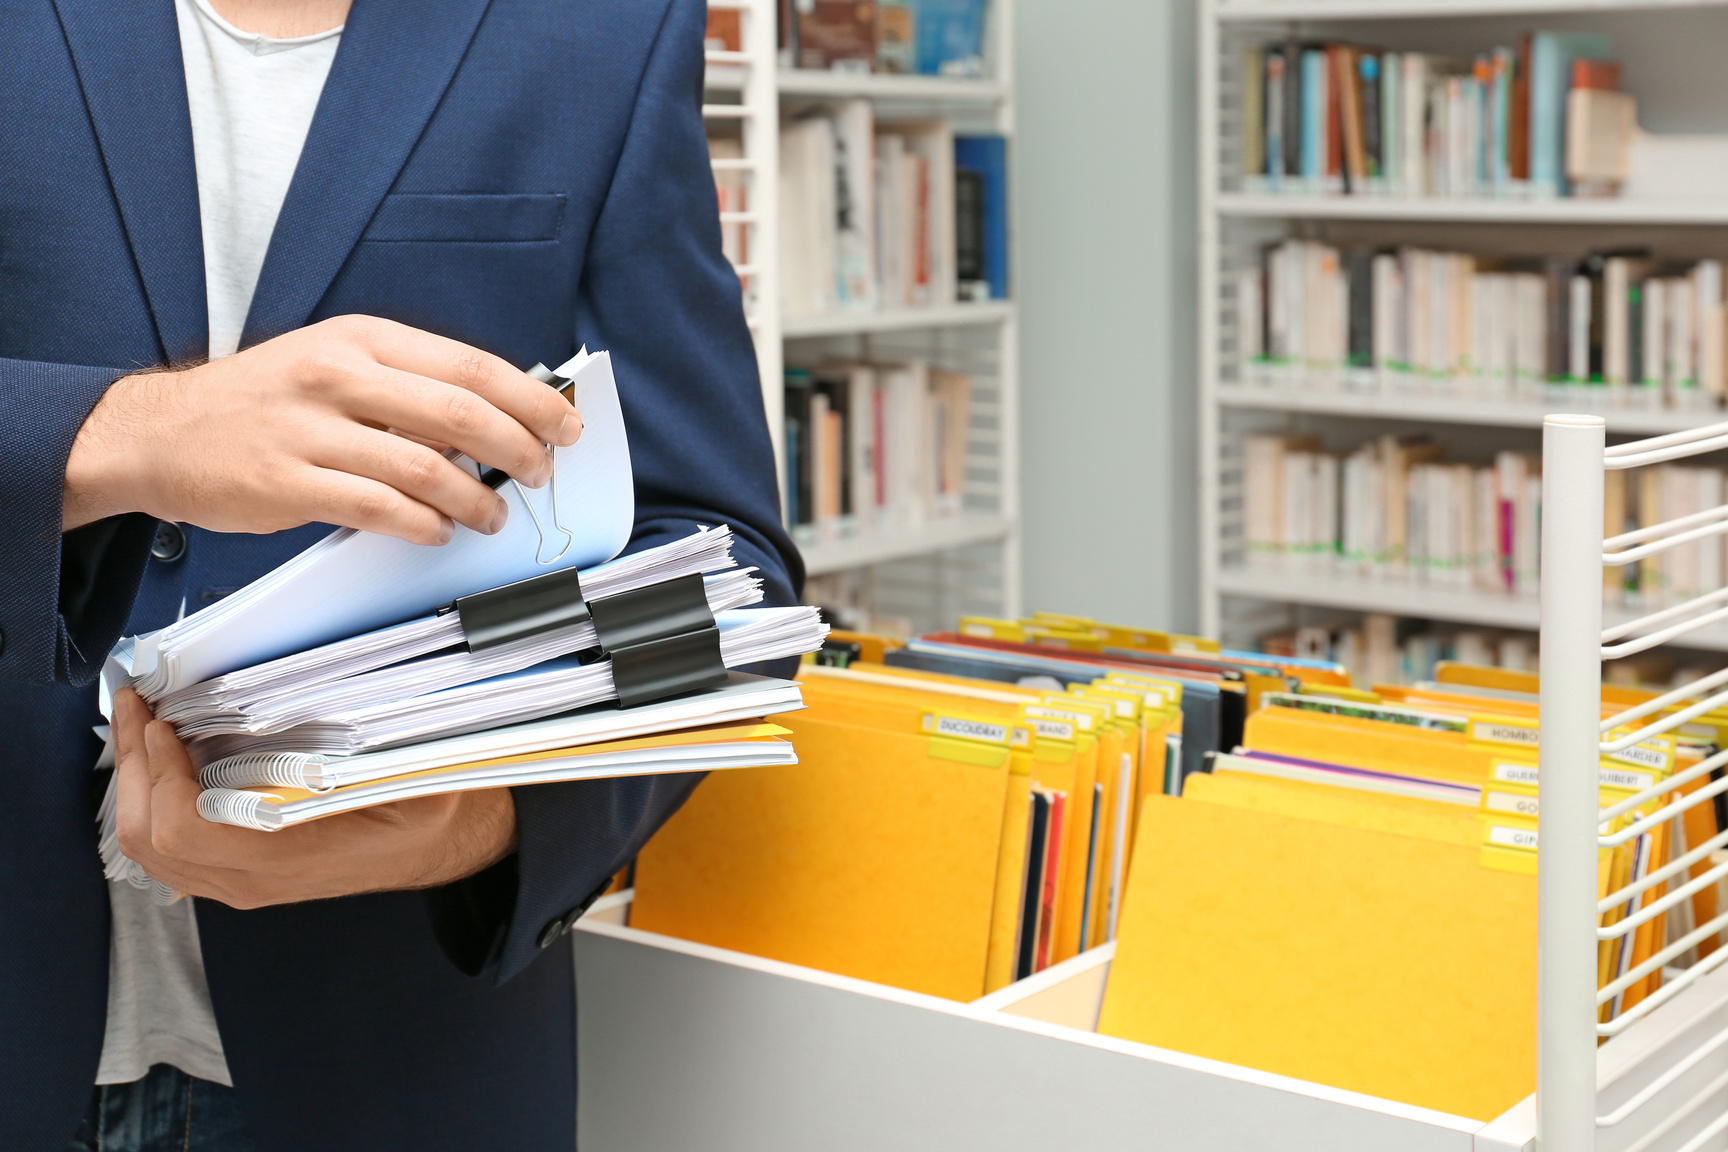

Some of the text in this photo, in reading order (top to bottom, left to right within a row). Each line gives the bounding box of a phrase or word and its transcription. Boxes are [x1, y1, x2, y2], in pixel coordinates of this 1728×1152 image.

[940, 719, 1003, 737] DUCOUDRAY
[1038, 723, 1068, 735] RAND
[1492, 727, 1538, 743] HOMBO
